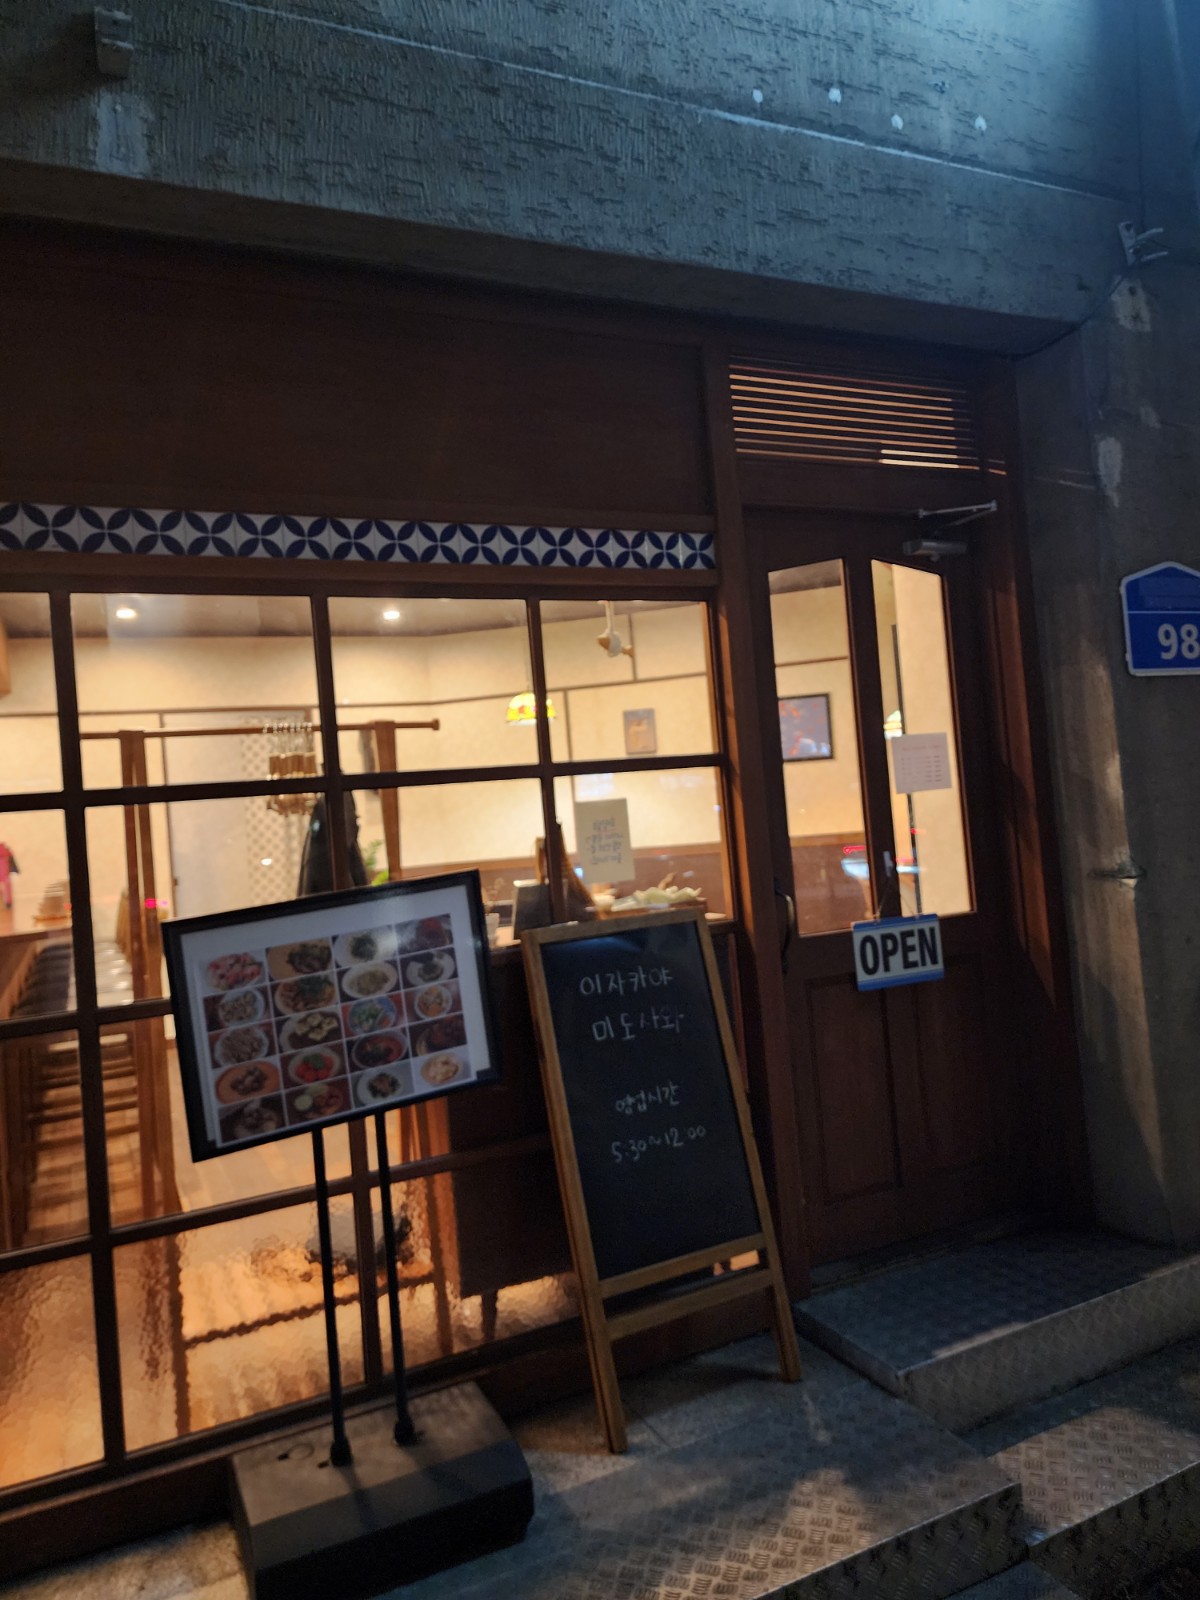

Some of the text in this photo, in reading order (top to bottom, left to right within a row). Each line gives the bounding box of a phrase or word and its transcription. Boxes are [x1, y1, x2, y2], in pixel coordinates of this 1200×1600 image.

[1157, 622, 1200, 660] 98
[860, 925, 939, 976] OPEN
[580, 965, 673, 995] 이자카야
[616, 1080, 680, 1115] 영업시간
